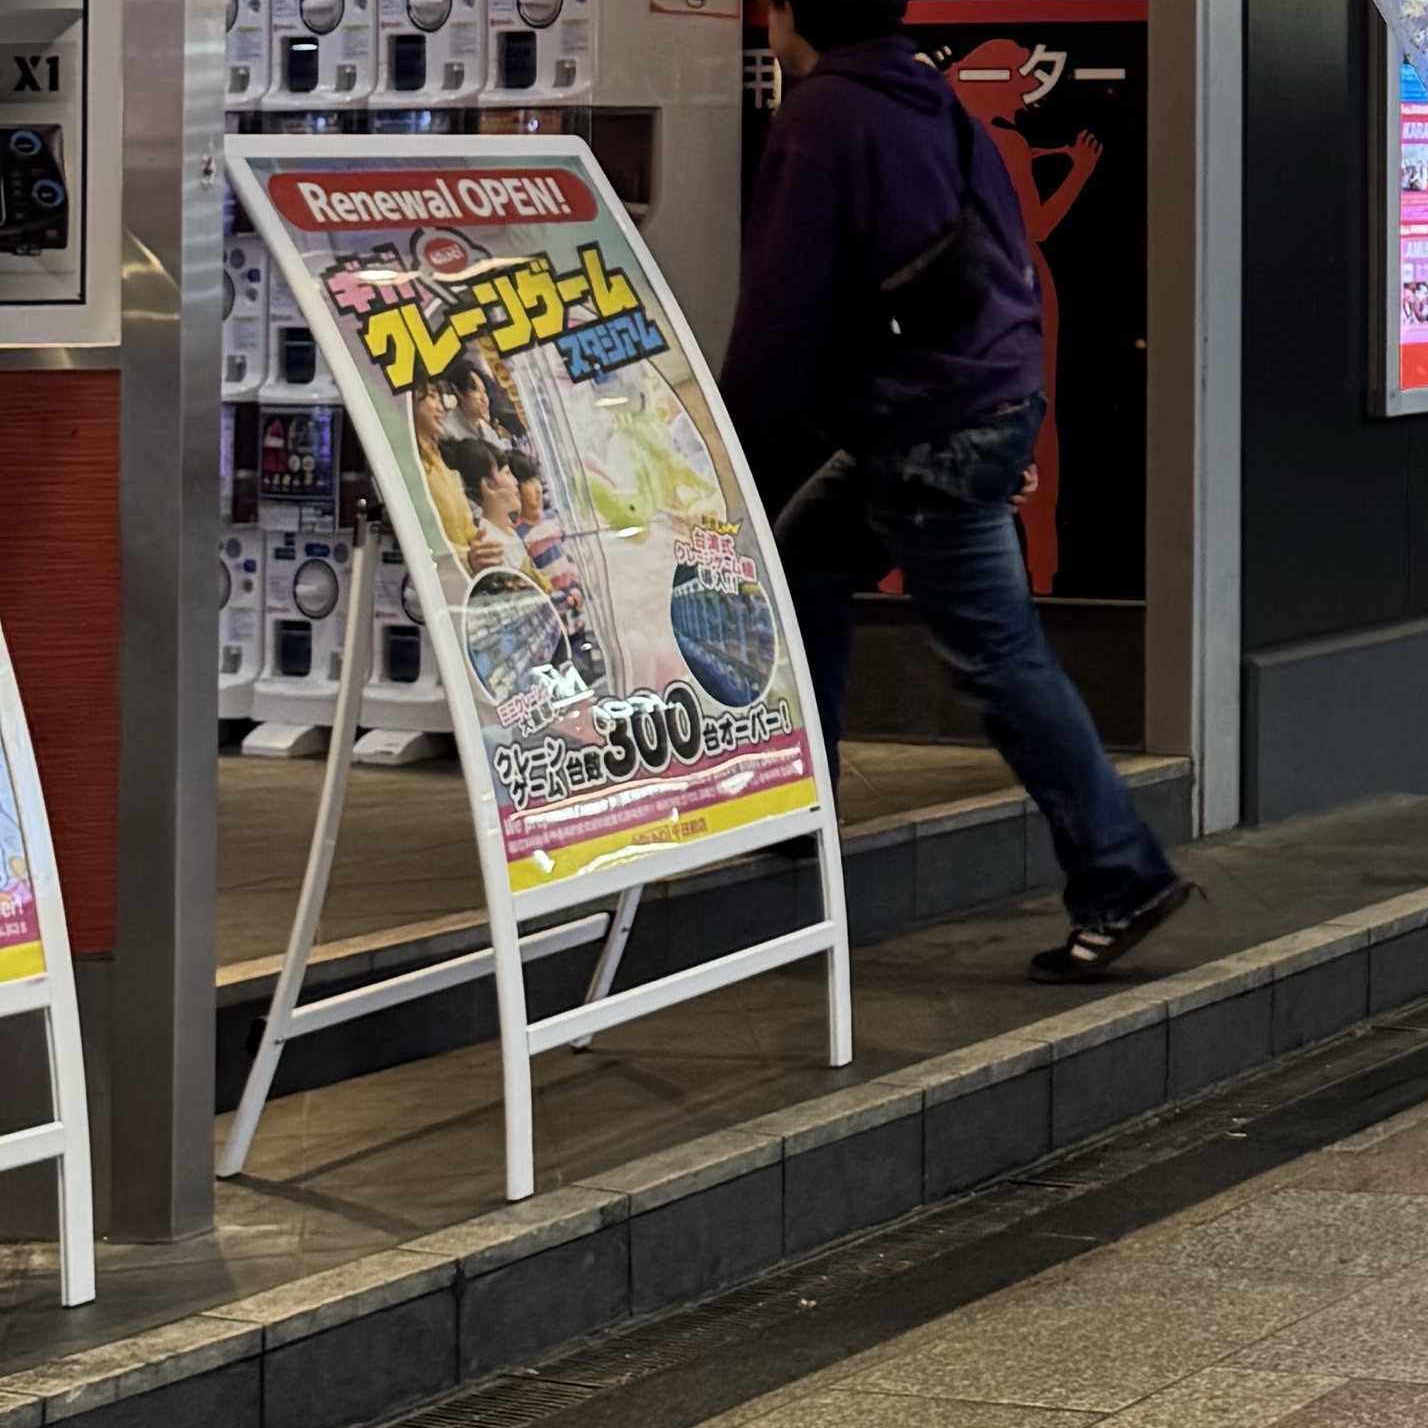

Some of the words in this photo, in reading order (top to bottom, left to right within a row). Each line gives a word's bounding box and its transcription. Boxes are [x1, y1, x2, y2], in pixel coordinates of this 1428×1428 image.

[296, 178, 464, 224] Renewal
[457, 176, 573, 220] OPEN!
[364, 248, 641, 391] クレーンゲーム
[557, 312, 664, 379] スタジアム
[593, 681, 704, 782] 300
[701, 698, 793, 756] 台オーバー!
[495, 738, 566, 784] クレーン
[511, 769, 567, 810] ゲーム
